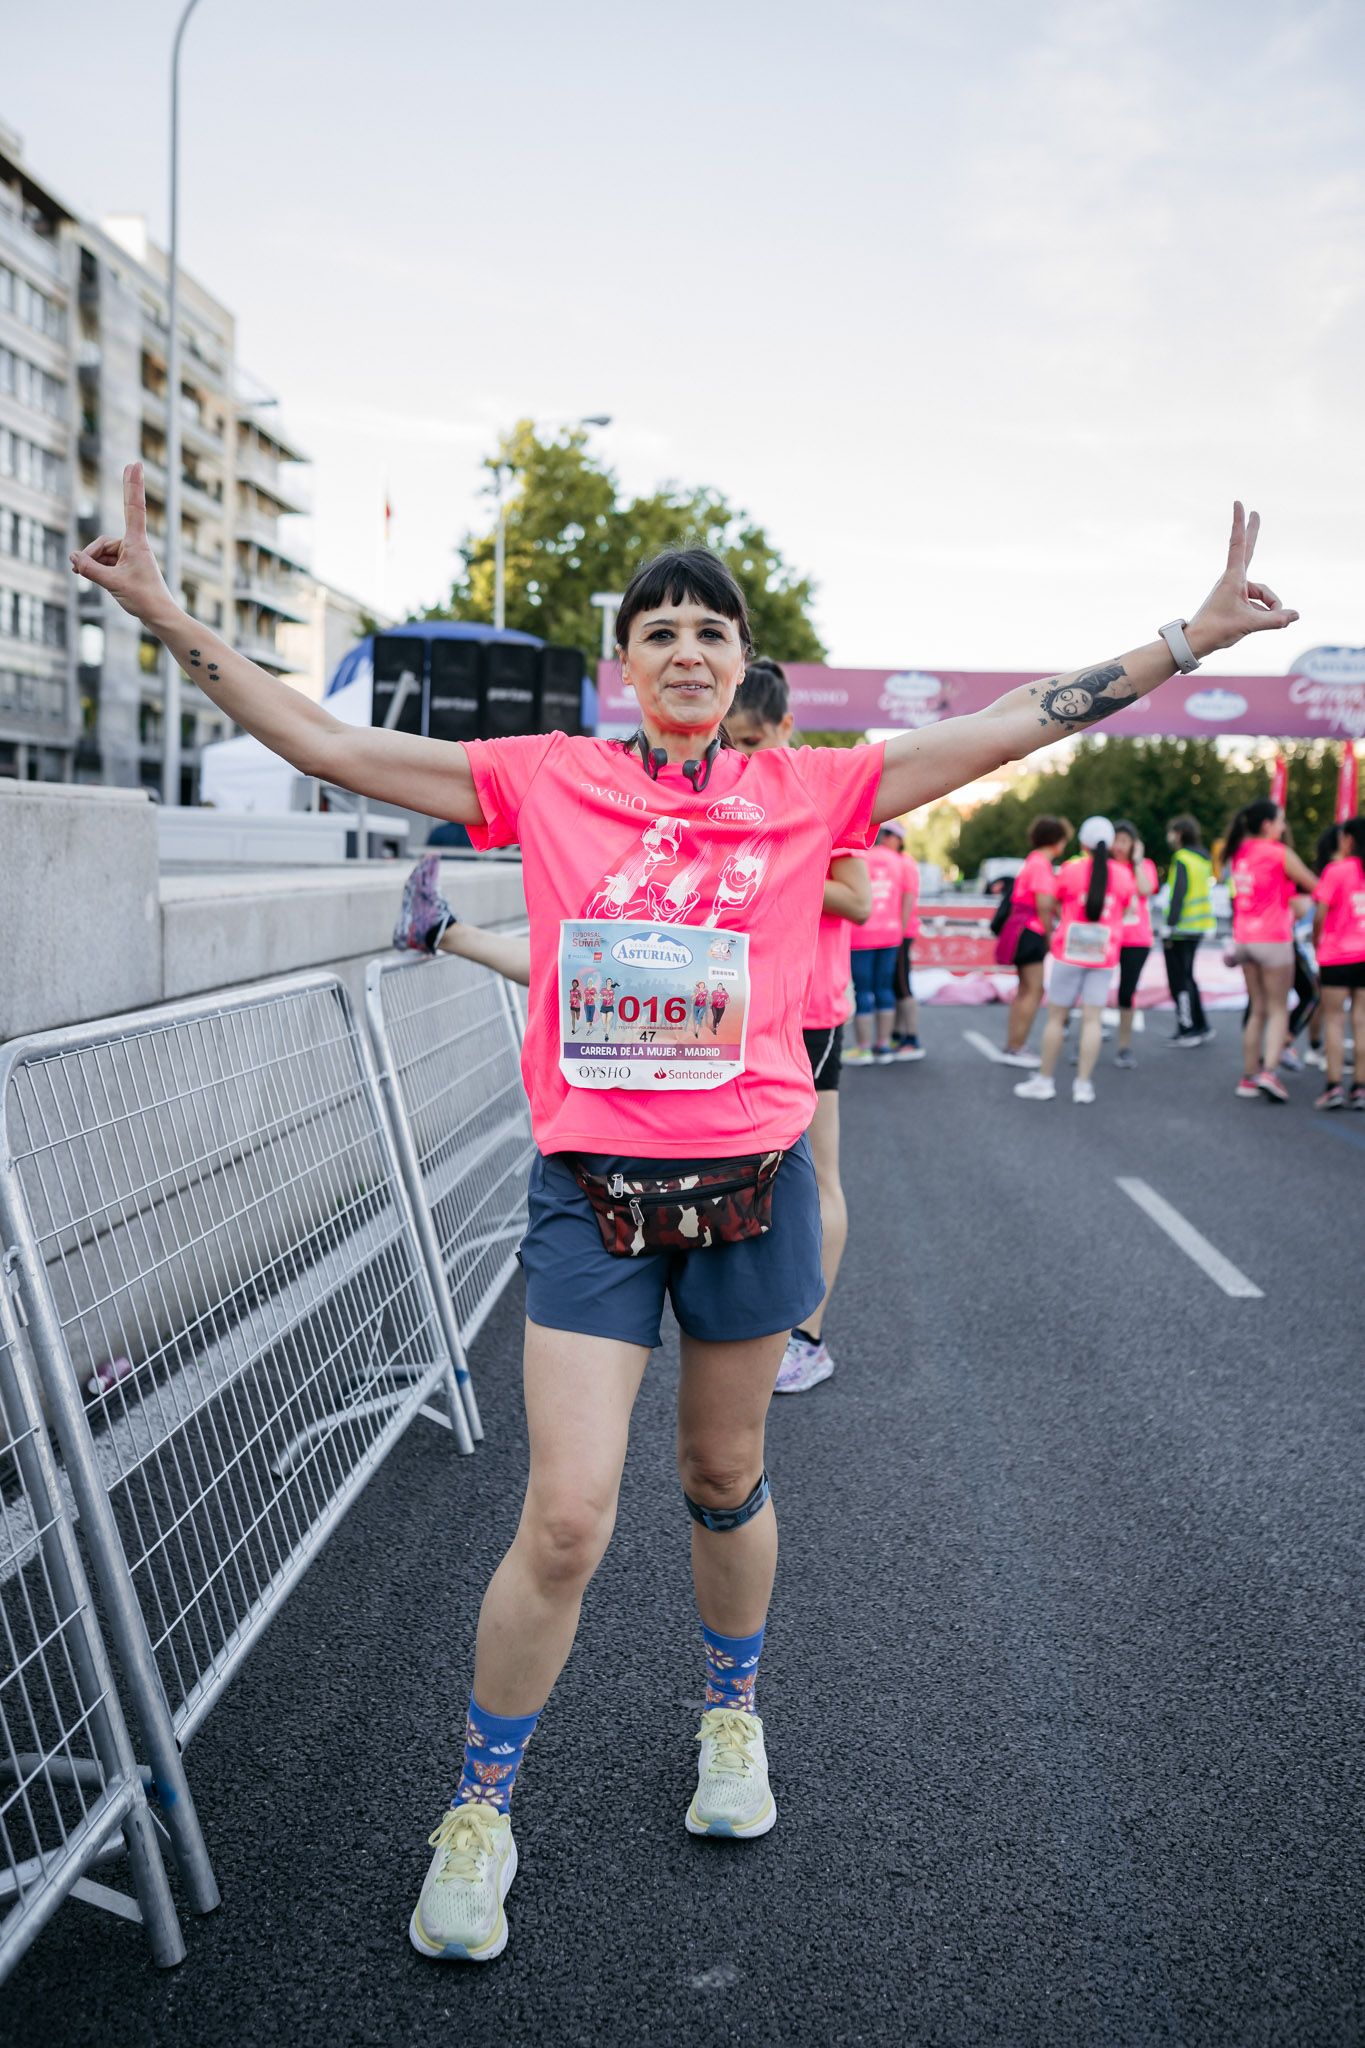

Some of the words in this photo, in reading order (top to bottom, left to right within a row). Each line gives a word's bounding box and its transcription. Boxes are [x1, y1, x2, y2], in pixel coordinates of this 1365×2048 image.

[617, 944, 687, 963] ASTURIANA
[618, 995, 687, 1024] 016
[639, 1031, 656, 1043] 47
[580, 1046, 618, 1056] CARRERA
[620, 1046, 631, 1056] DE
[632, 1046, 644, 1056] LA
[646, 1046, 677, 1057] MUJER
[684, 1047, 720, 1057] MADRID
[579, 1065, 631, 1079] OYSHO
[668, 1069, 723, 1080] Santander
